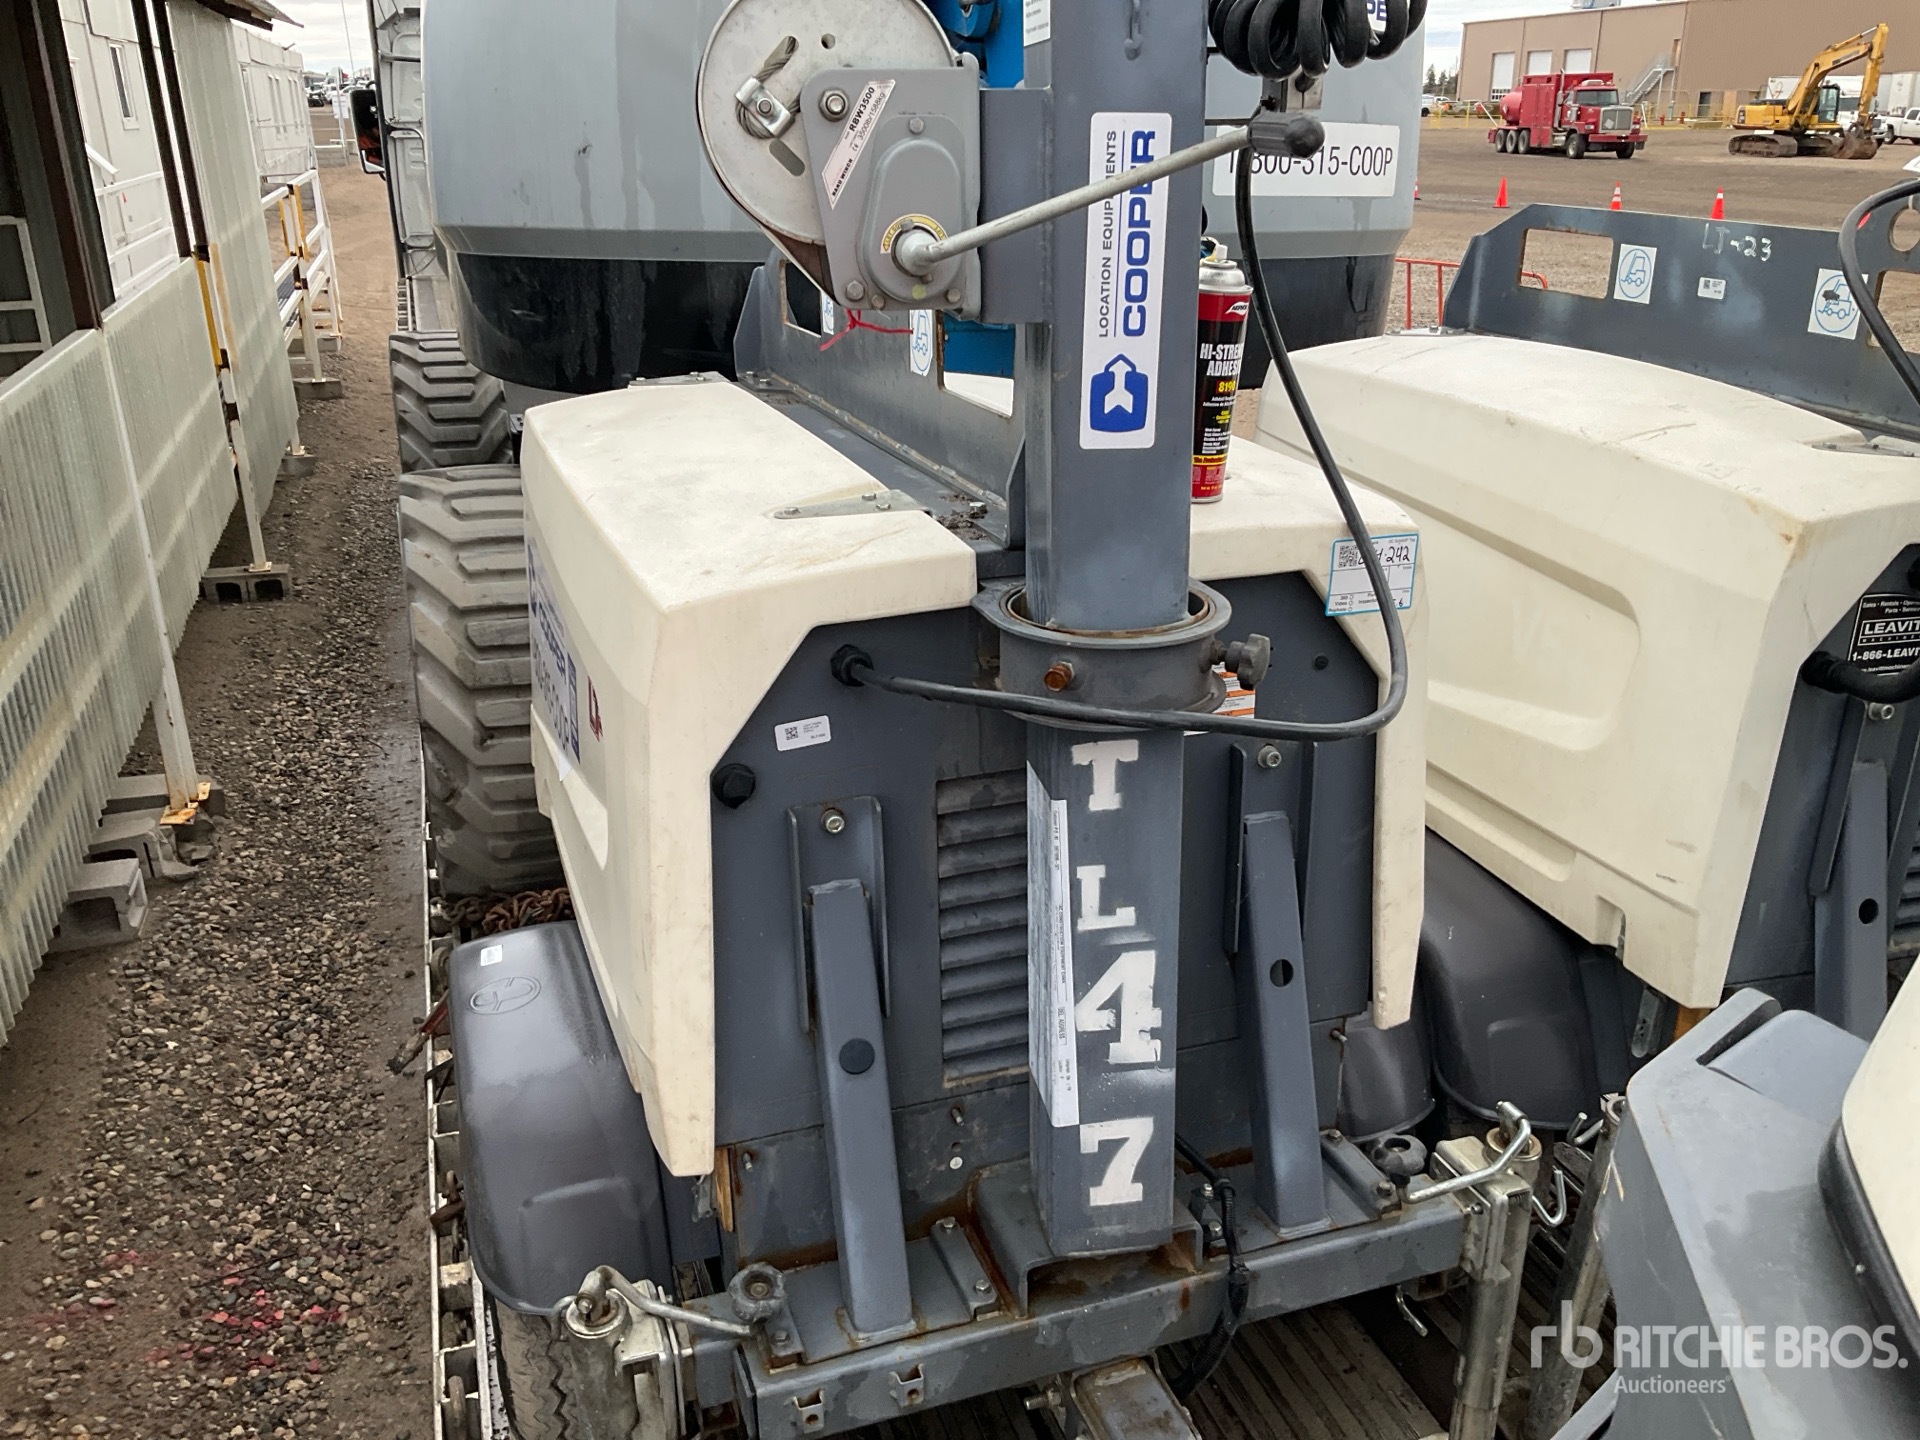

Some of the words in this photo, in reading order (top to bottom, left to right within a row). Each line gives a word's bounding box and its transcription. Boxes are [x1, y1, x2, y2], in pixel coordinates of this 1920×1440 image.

[848, 86, 876, 132] RBW3500
[857, 92, 885, 140] 3500lb/1588kg
[831, 179, 843, 197] HAND
[840, 158, 853, 180] WINCH
[1102, 130, 1117, 250] EQUIPENTS
[1099, 256, 1112, 338] LOCATION
